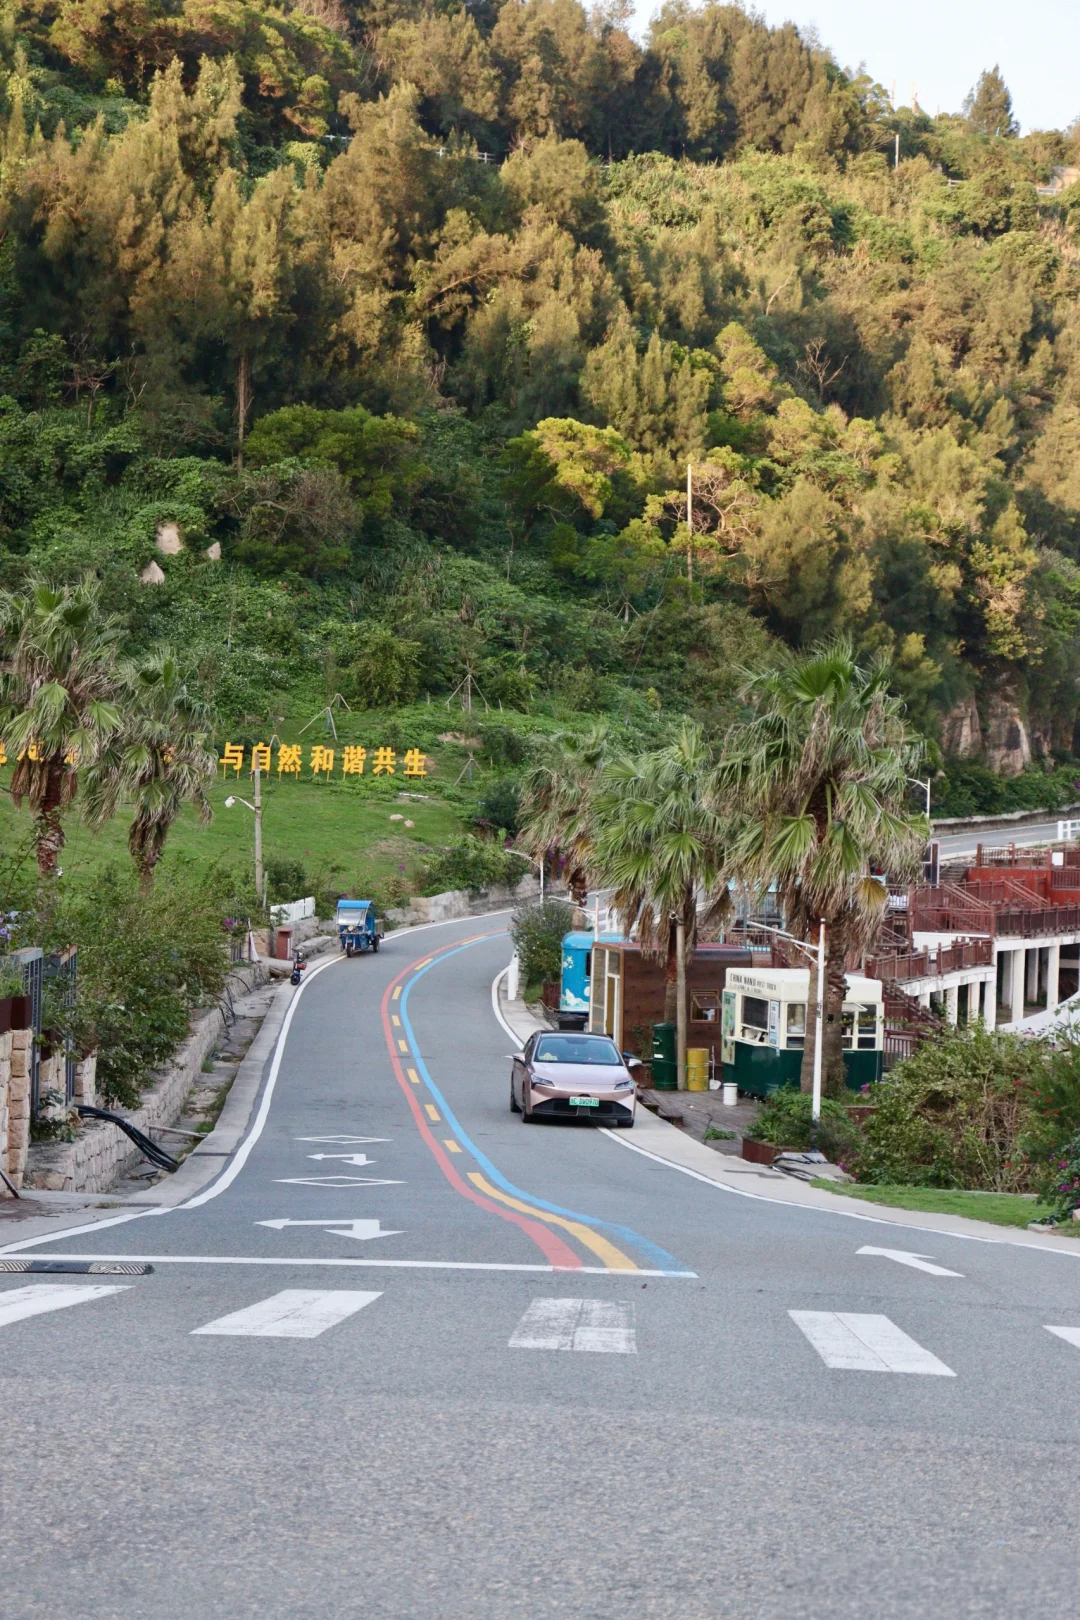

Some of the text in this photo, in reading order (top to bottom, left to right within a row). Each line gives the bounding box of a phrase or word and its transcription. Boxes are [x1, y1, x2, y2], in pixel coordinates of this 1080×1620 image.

[219, 742, 427, 775] 与自然和谐共生
